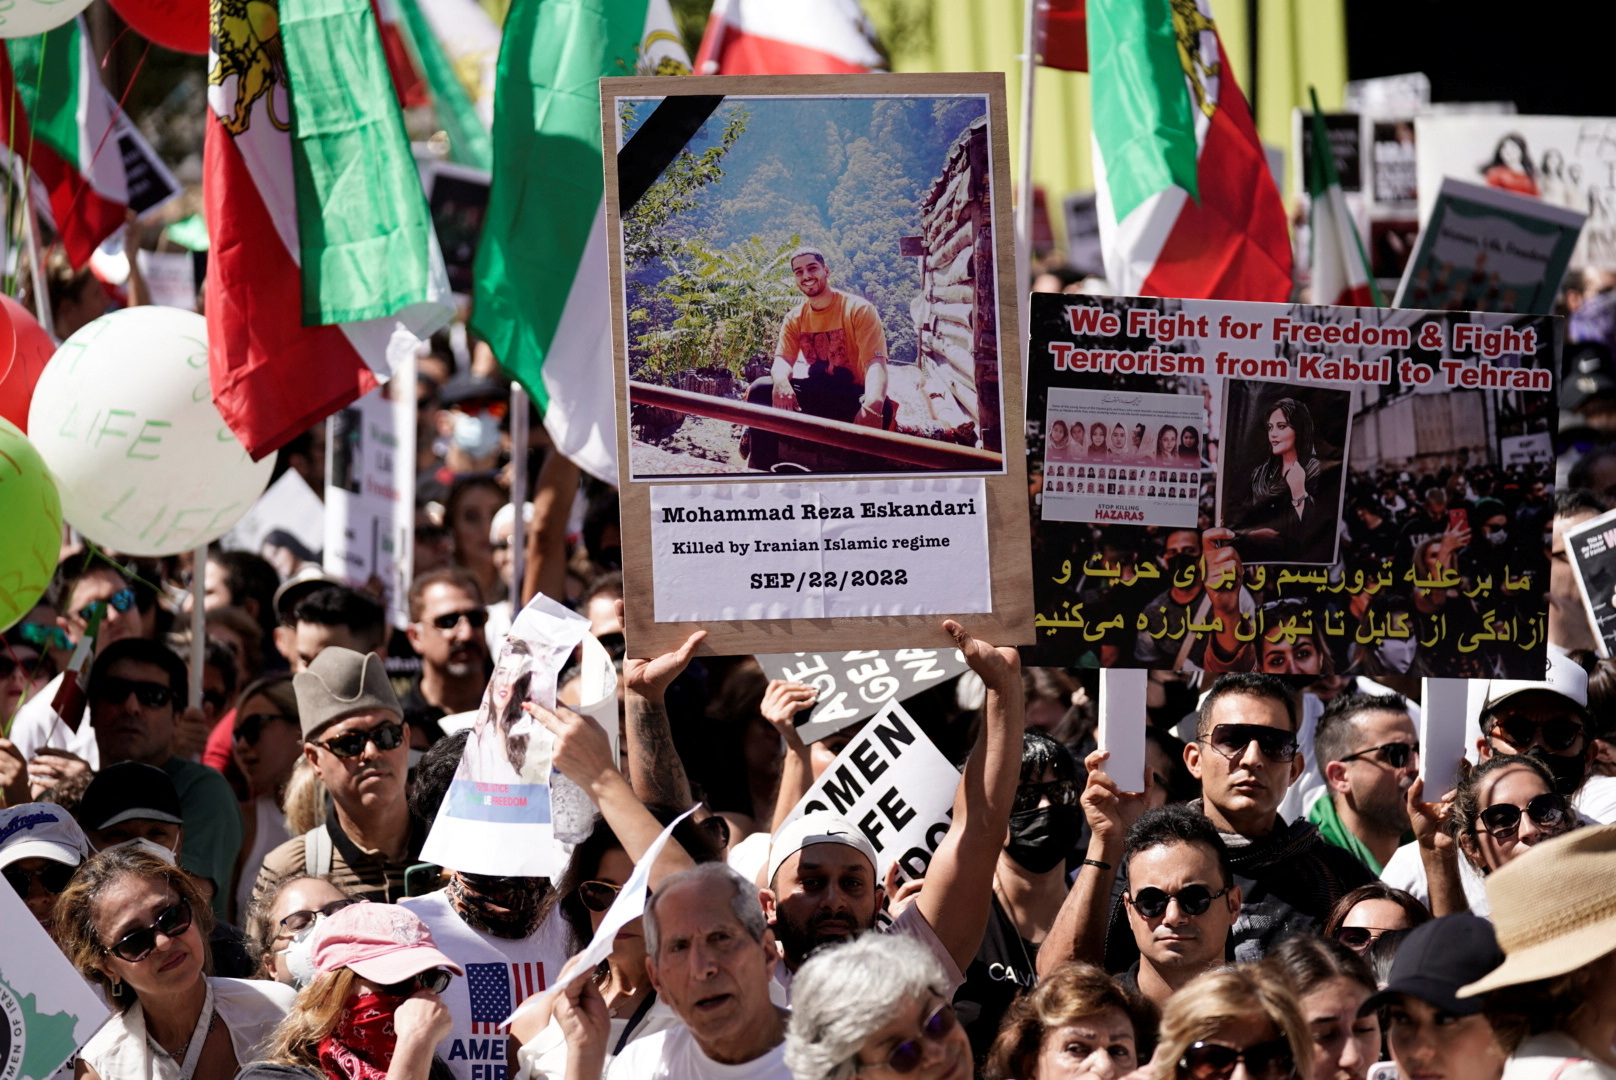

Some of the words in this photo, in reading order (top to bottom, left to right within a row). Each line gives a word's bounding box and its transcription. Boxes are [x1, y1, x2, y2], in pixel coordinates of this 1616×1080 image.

[1069, 307, 1120, 335] We
[1128, 310, 1209, 342] Fight
[1218, 314, 1263, 341] for
[1272, 316, 1409, 348] Freedom
[1420, 323, 1443, 349] &
[1454, 325, 1535, 357] Fight
[1050, 344, 1206, 375] Terrorism
[1215, 351, 1289, 378] from
[1299, 355, 1390, 382] Kabul
[1399, 363, 1432, 384] to
[1442, 362, 1550, 390] Tehran
[58, 403, 172, 461] LIFE
[662, 504, 795, 523] Mohammad
[801, 504, 855, 520] Reza
[860, 498, 976, 518] Eskandari
[1094, 509, 1144, 521] HAZARAS
[1115, 504, 1140, 512] KILLING
[672, 541, 725, 554] Killed
[729, 541, 750, 556] by
[754, 538, 819, 552] Iranian
[824, 536, 887, 551] Islamic
[892, 535, 950, 551] regime
[750, 569, 908, 593] SEP/22/2022
[1051, 558, 1071, 585] و
[1083, 553, 1160, 586] حریت
[1173, 553, 1236, 590] برای
[1246, 564, 1266, 591] و
[1276, 560, 1393, 597] تروریسم
[1403, 560, 1461, 596] علیه
[1503, 564, 1531, 591] ما
[1463, 573, 1492, 597] بر
[1136, 605, 1223, 640] مبارزه
[1234, 608, 1313, 645] تهران
[1324, 609, 1345, 635] تا
[1355, 608, 1410, 647] کابل
[1420, 613, 1447, 648] از
[12, 1019, 23, 1038] OF
[447, 1039, 508, 1060] AME
